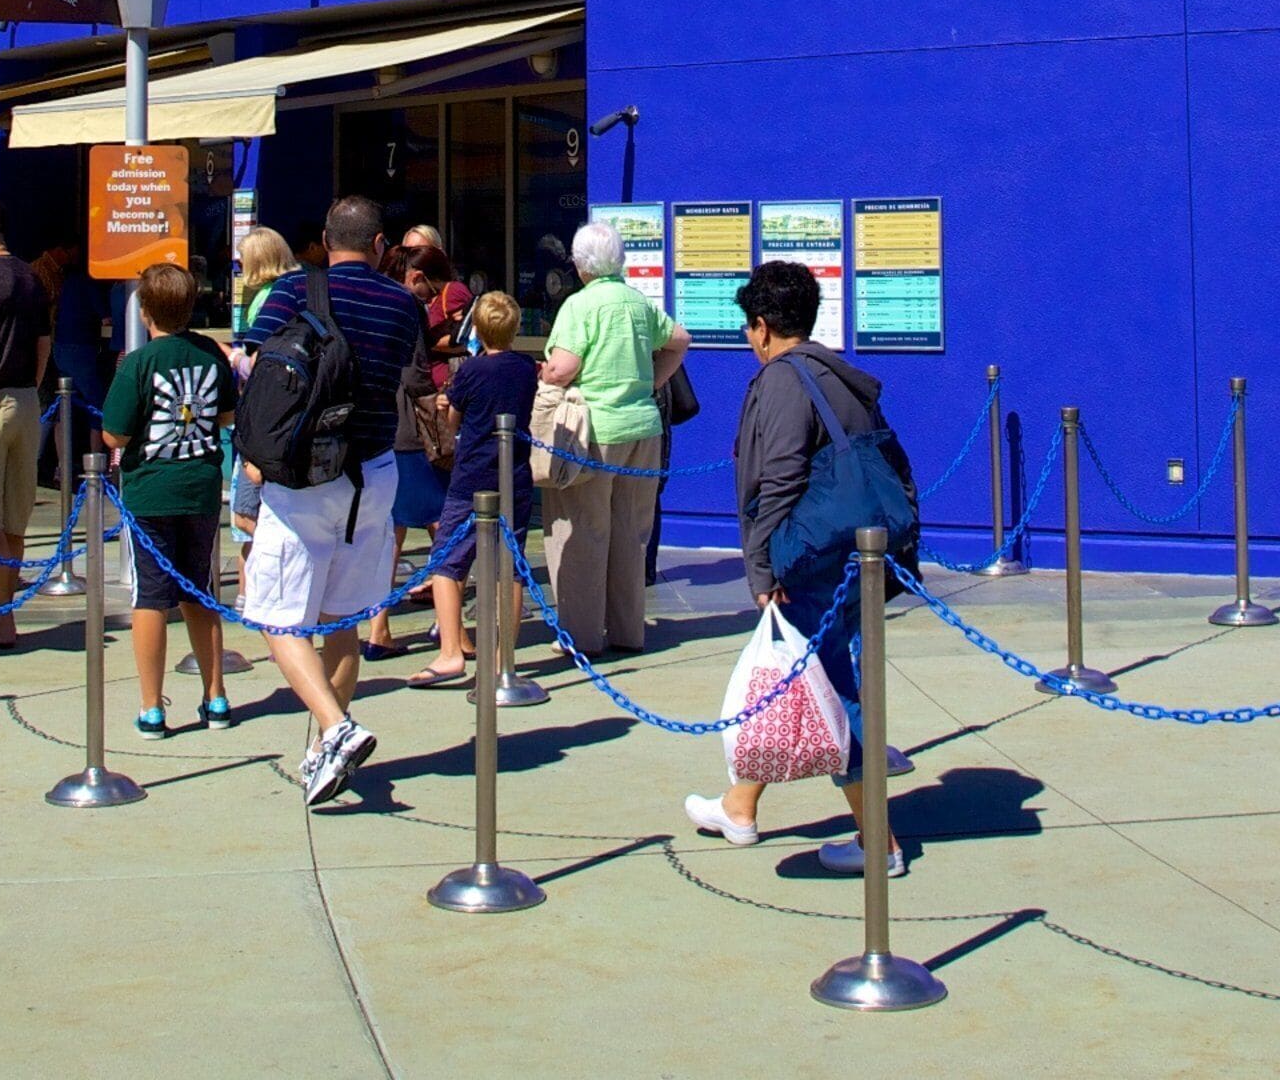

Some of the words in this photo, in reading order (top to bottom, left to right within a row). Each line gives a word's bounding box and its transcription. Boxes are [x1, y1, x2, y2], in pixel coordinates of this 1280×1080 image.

[567, 128, 579, 157] 9
[124, 153, 153, 165] Free
[387, 142, 396, 169] 7
[206, 151, 214, 175] 6
[111, 169, 166, 178] admission
[107, 183, 138, 193] today
[140, 183, 171, 192] when
[126, 196, 151, 208] you
[559, 195, 586, 207] CLOS
[112, 210, 155, 219] become
[157, 211, 165, 219] a
[107, 221, 169, 233] Member!
